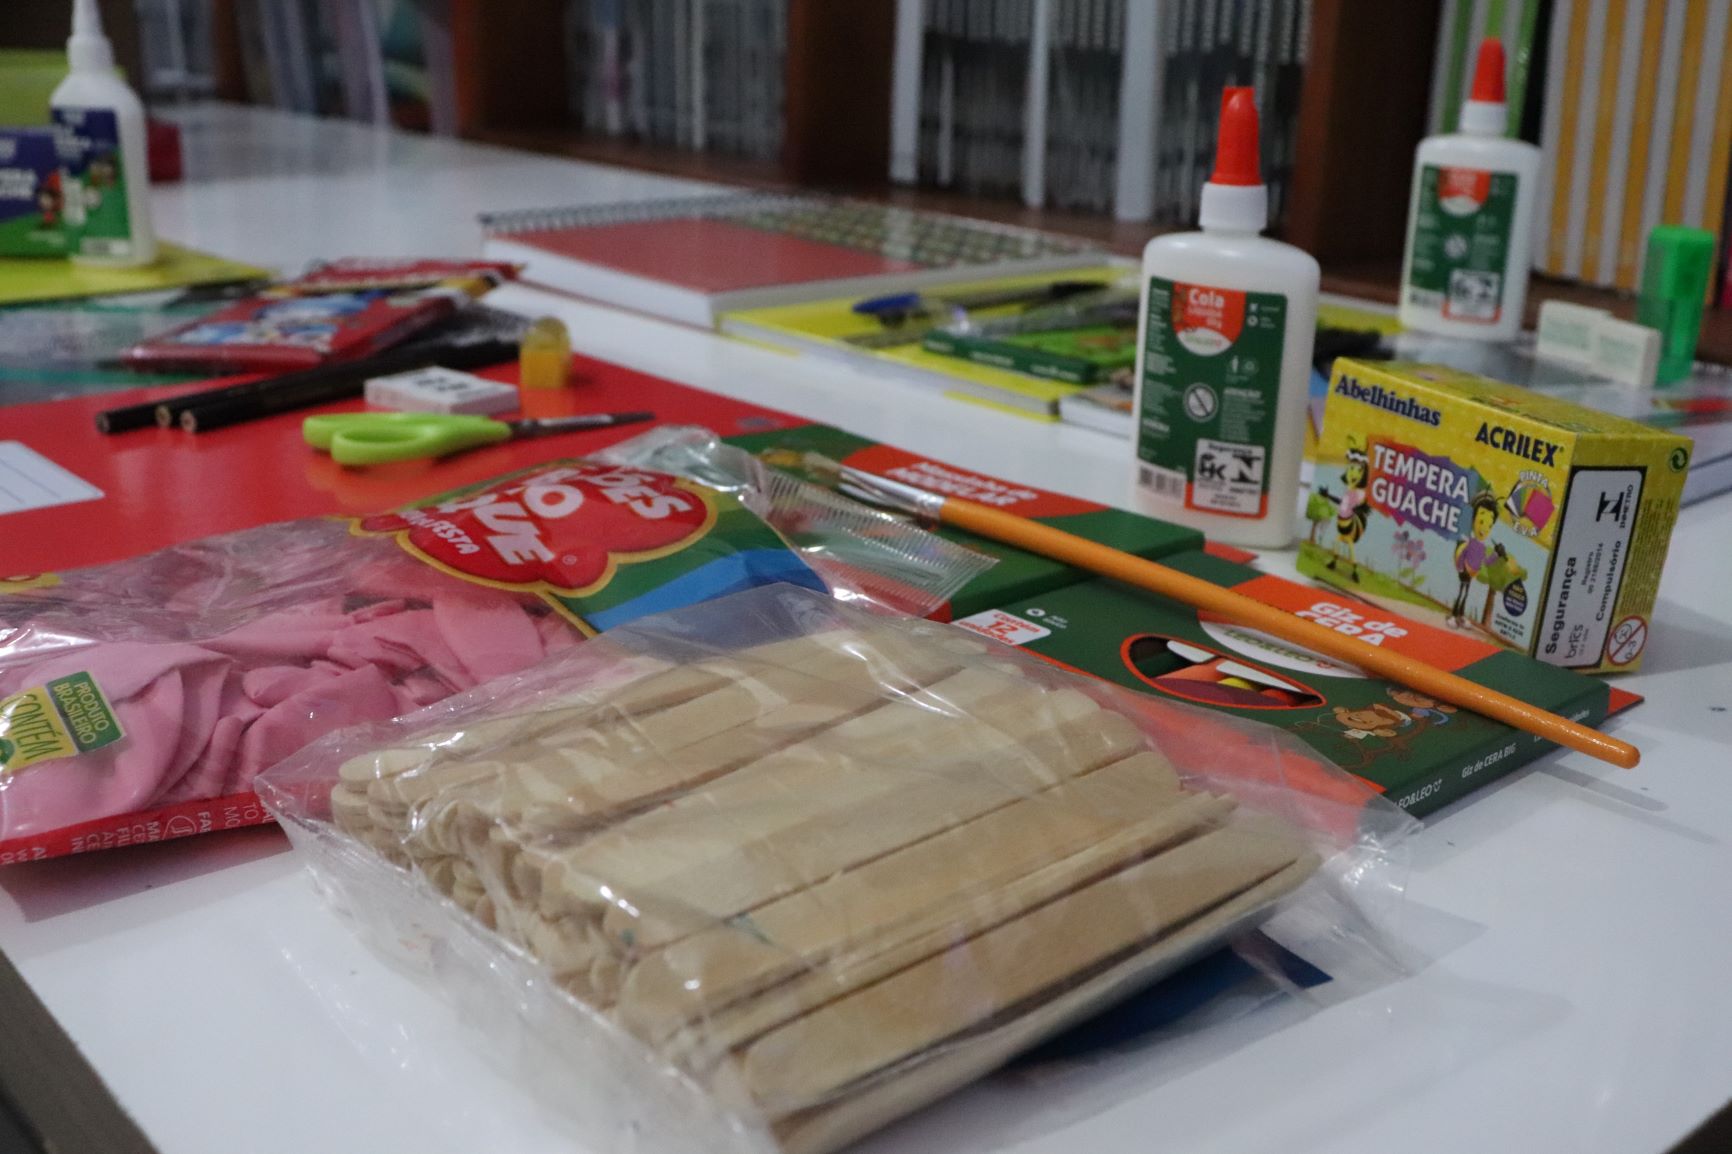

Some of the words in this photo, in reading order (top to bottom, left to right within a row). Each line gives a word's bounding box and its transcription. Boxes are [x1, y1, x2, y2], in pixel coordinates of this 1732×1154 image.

[1189, 287, 1225, 309] Cola
[1335, 374, 1441, 427] Abelhinhas
[1475, 422, 1558, 468] ACRILEX
[588, 466, 693, 519] ÕES
[1374, 444, 1470, 504] TEMPERA
[1519, 470, 1548, 489] PINTA
[1372, 477, 1461, 533] GUACHE
[427, 519, 480, 555] FESTA
[1545, 556, 1577, 655] Segurança
[1595, 540, 1622, 622] Compulsório
[988, 620, 1019, 635] 12
[1310, 602, 1363, 623] Giz
[1362, 619, 1409, 638] de
[3, 694, 63, 761] CONTÉM
[53, 682, 97, 745] BRASILEIRO
[74, 681, 110, 732] PRODUTO
[1462, 766, 1474, 779] Giz
[1474, 760, 1484, 773] de
[1484, 749, 1503, 768] CERA
